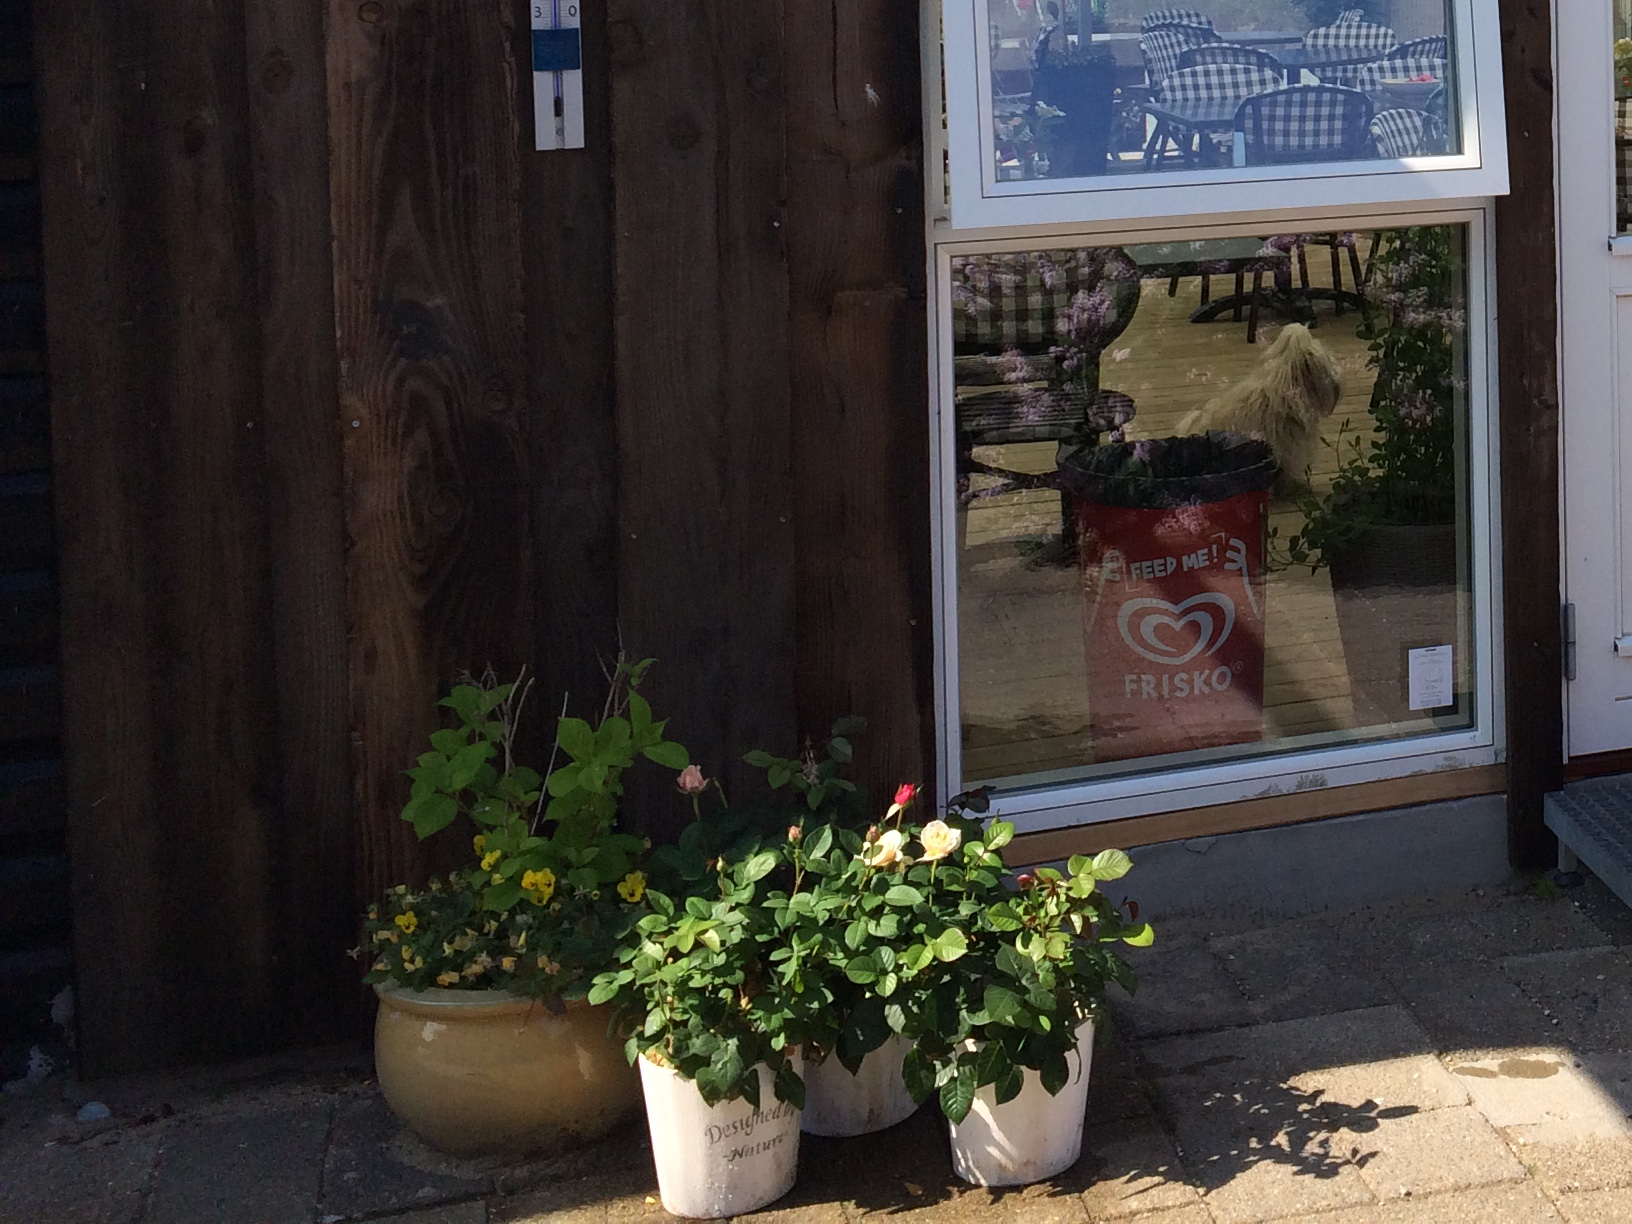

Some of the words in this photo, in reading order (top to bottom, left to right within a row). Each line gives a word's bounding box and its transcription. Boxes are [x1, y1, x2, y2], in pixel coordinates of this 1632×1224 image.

[1130, 557, 1177, 582] FEED
[1181, 544, 1219, 572] ME!
[1125, 665, 1232, 699] FRISKO
[705, 1101, 782, 1145] Designed
